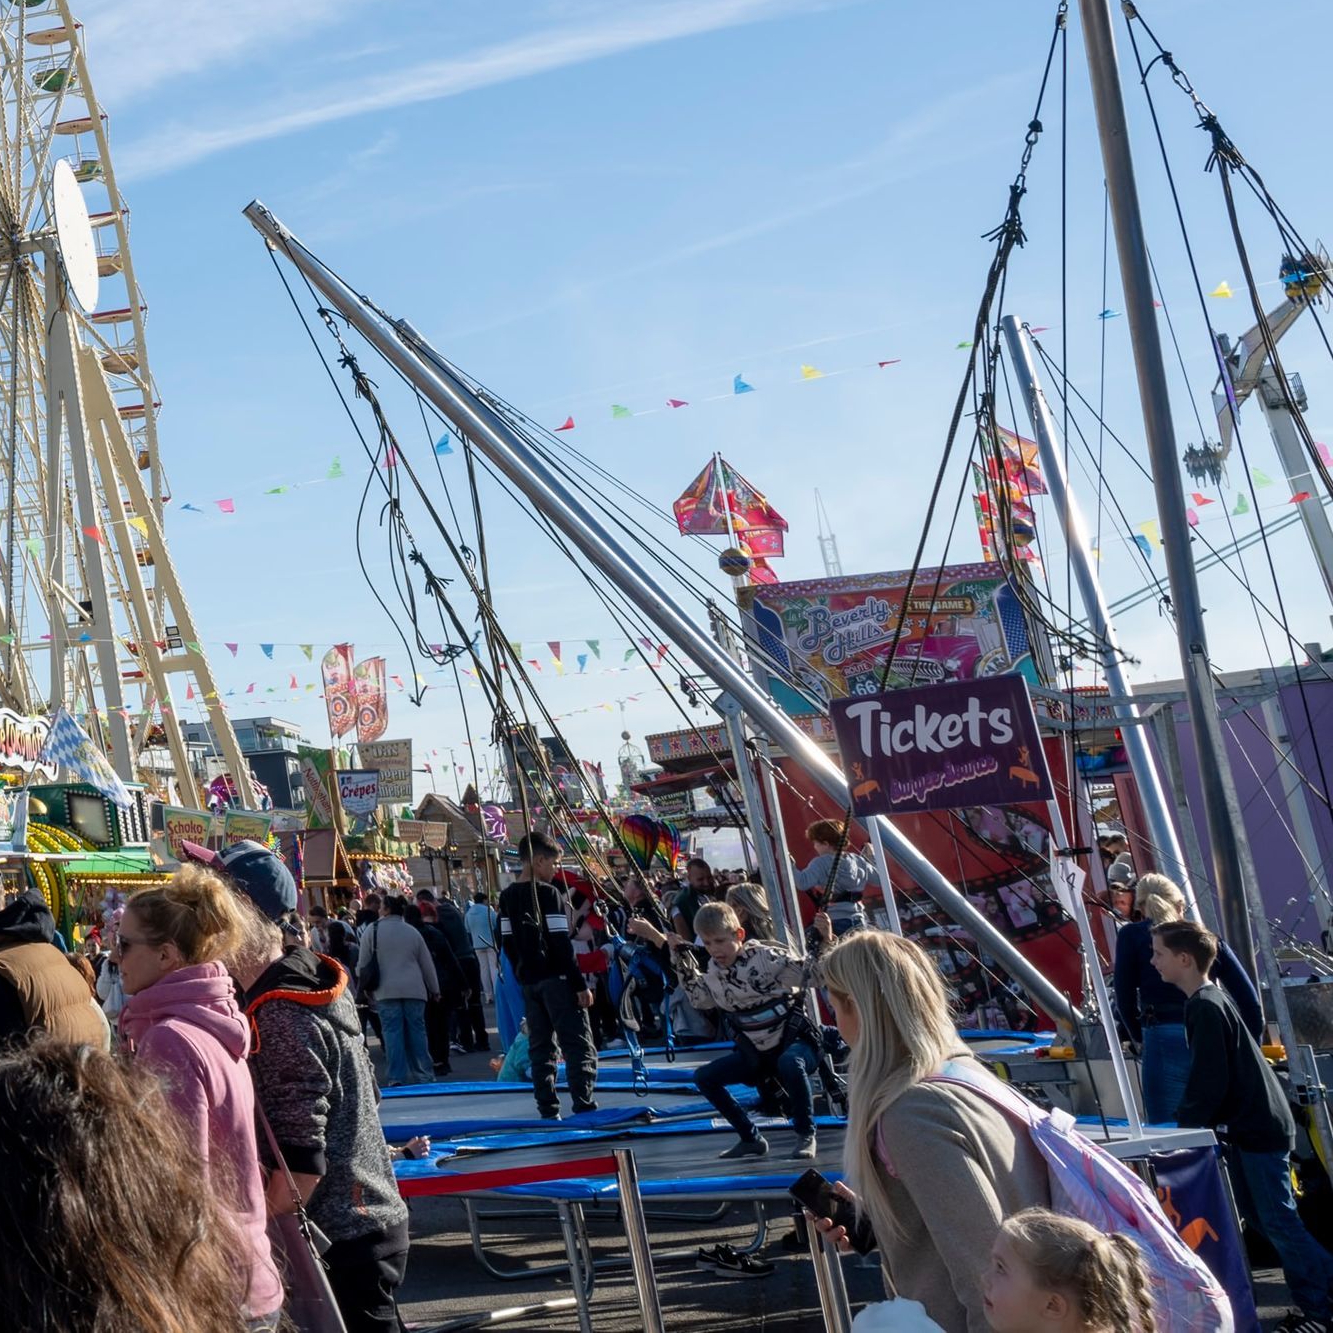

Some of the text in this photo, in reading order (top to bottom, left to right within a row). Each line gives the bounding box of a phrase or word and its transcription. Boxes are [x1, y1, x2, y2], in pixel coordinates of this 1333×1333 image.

[936, 598, 965, 611] GAME
[798, 596, 892, 652] Beverly
[844, 663, 869, 675] ROUTE
[845, 697, 1014, 758] Tickets
[167, 820, 207, 835] Schoko-
